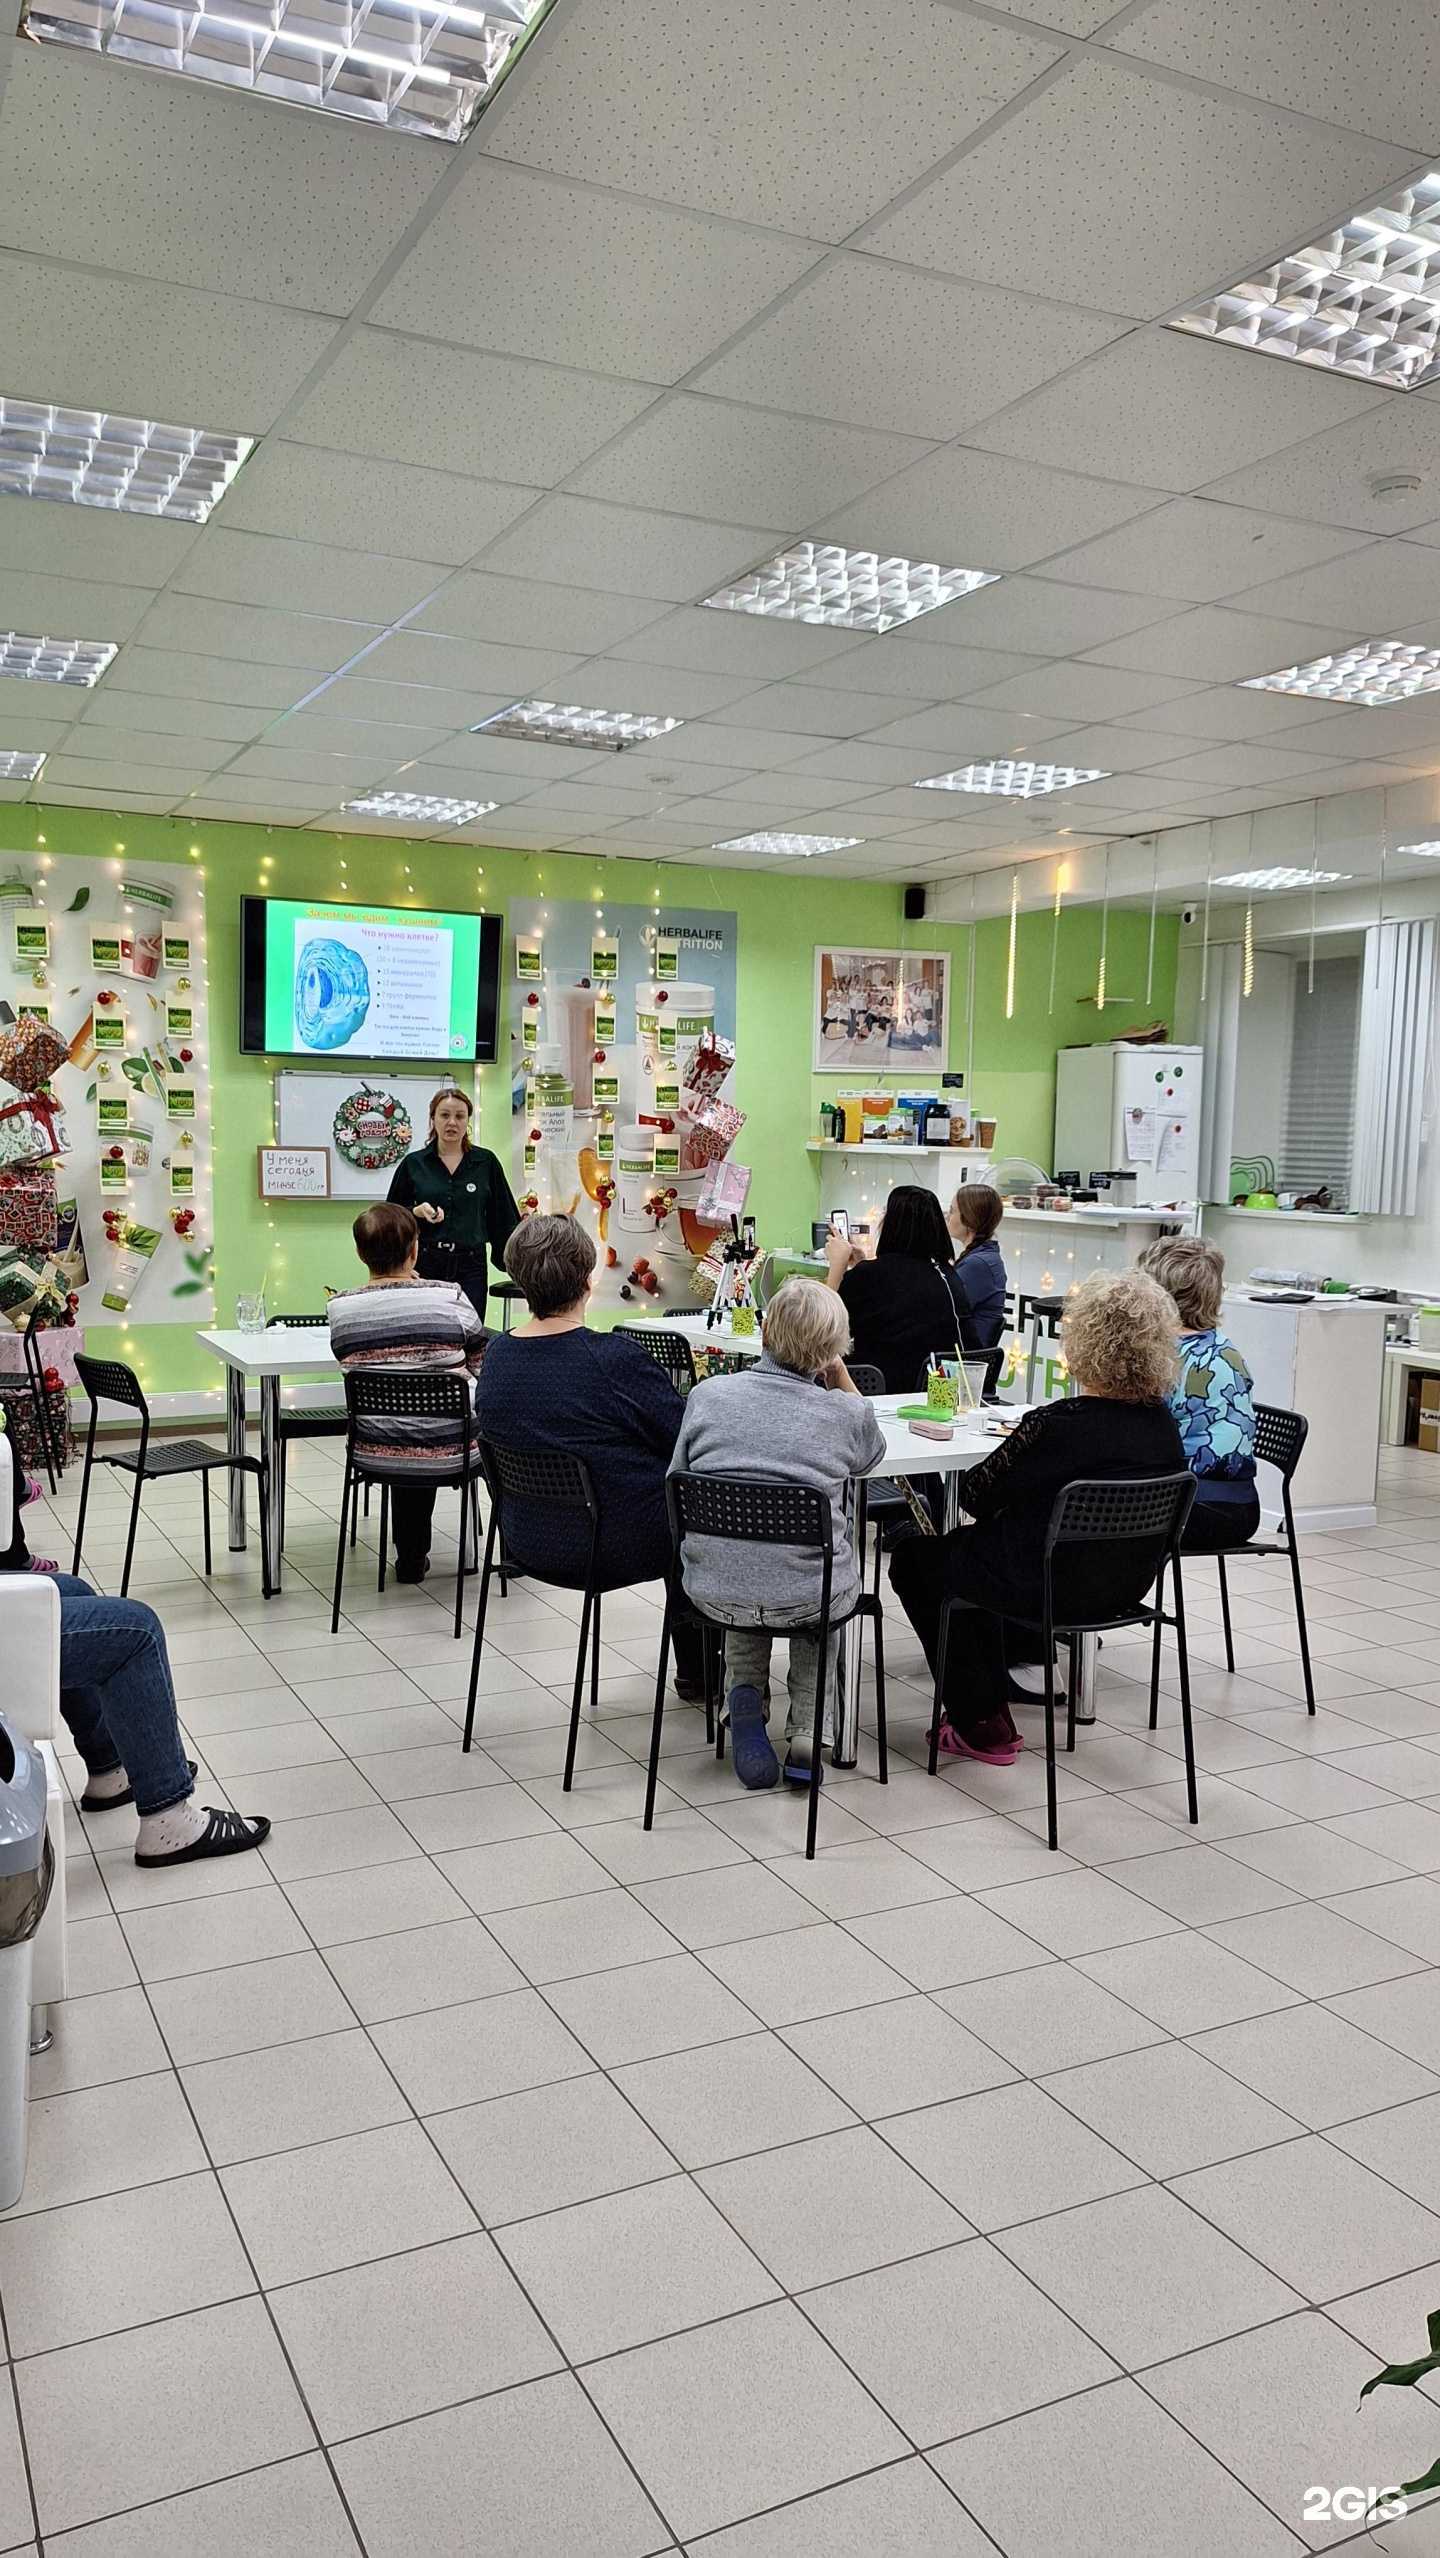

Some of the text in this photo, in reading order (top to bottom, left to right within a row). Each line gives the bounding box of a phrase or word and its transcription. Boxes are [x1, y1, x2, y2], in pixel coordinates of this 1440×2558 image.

[361, 928, 377, 937] Что
[658, 927, 723, 940] HERBALIFE
[279, 1155, 309, 1166] меня
[267, 1167, 315, 1177] сегодня
